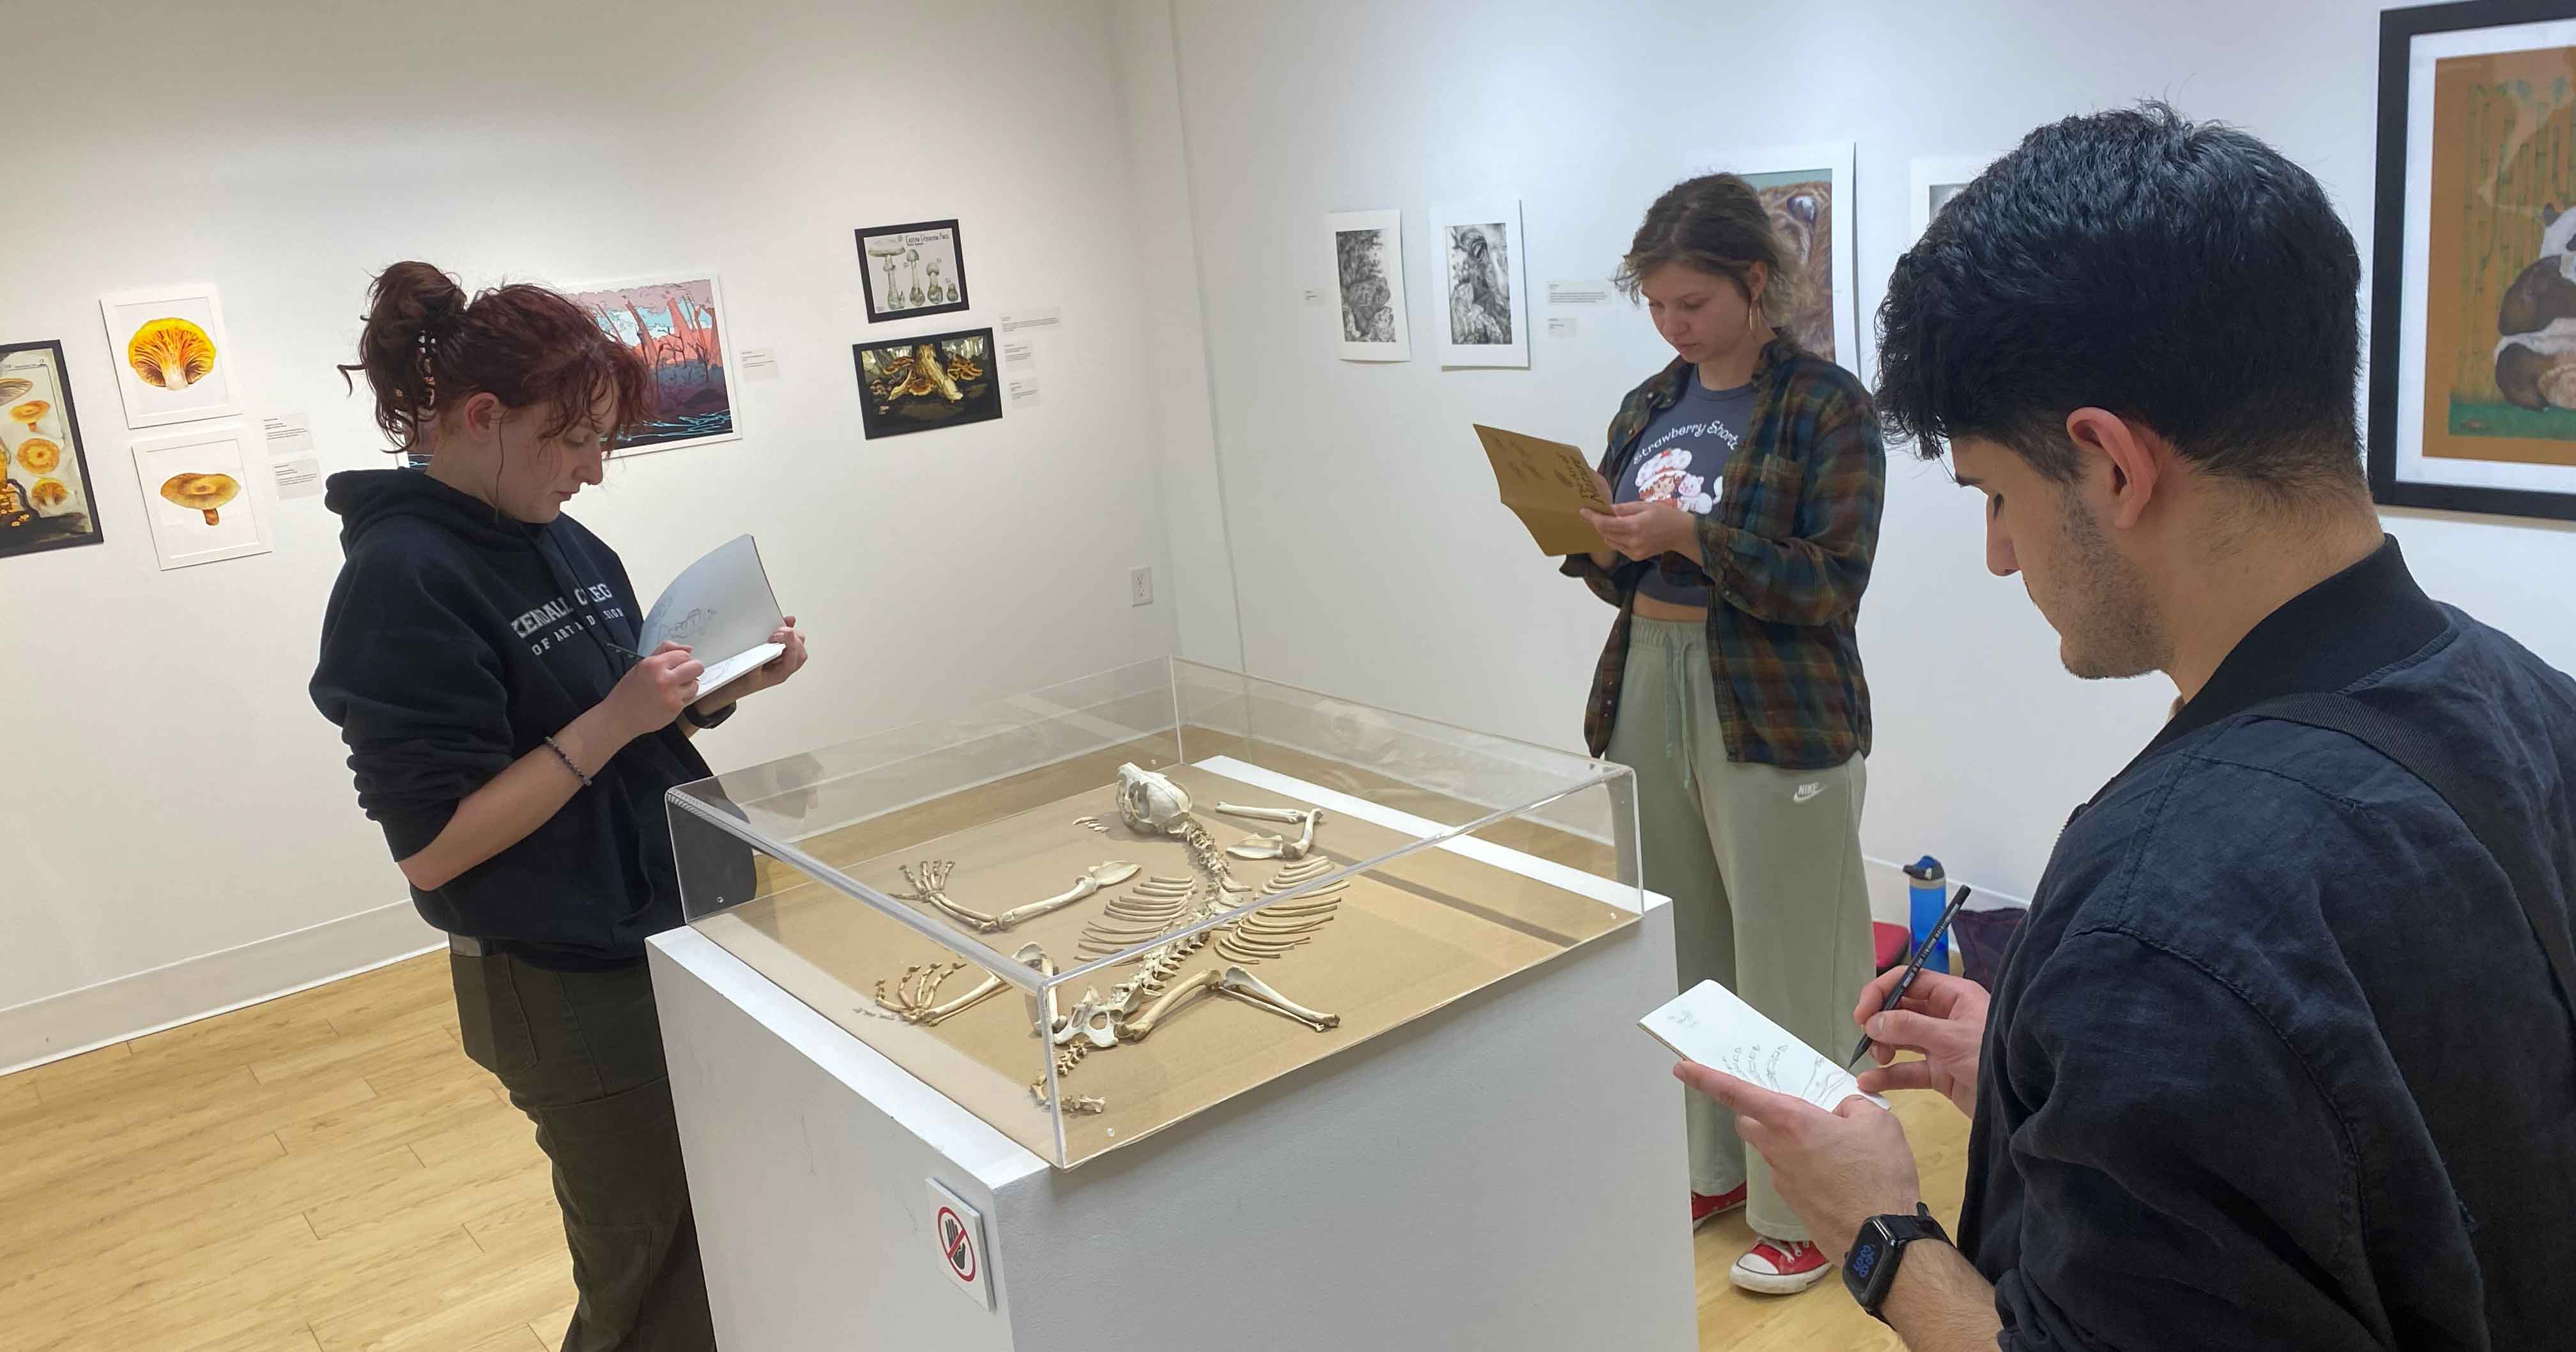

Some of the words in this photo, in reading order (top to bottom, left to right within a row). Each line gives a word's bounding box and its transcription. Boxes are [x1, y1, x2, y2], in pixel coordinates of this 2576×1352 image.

[1634, 423, 1706, 465] Strawberry
[1706, 420, 1739, 450] Shortc
[532, 637, 551, 656] OF
[553, 625, 575, 641] ART
[1798, 781, 1820, 795] NIKE
